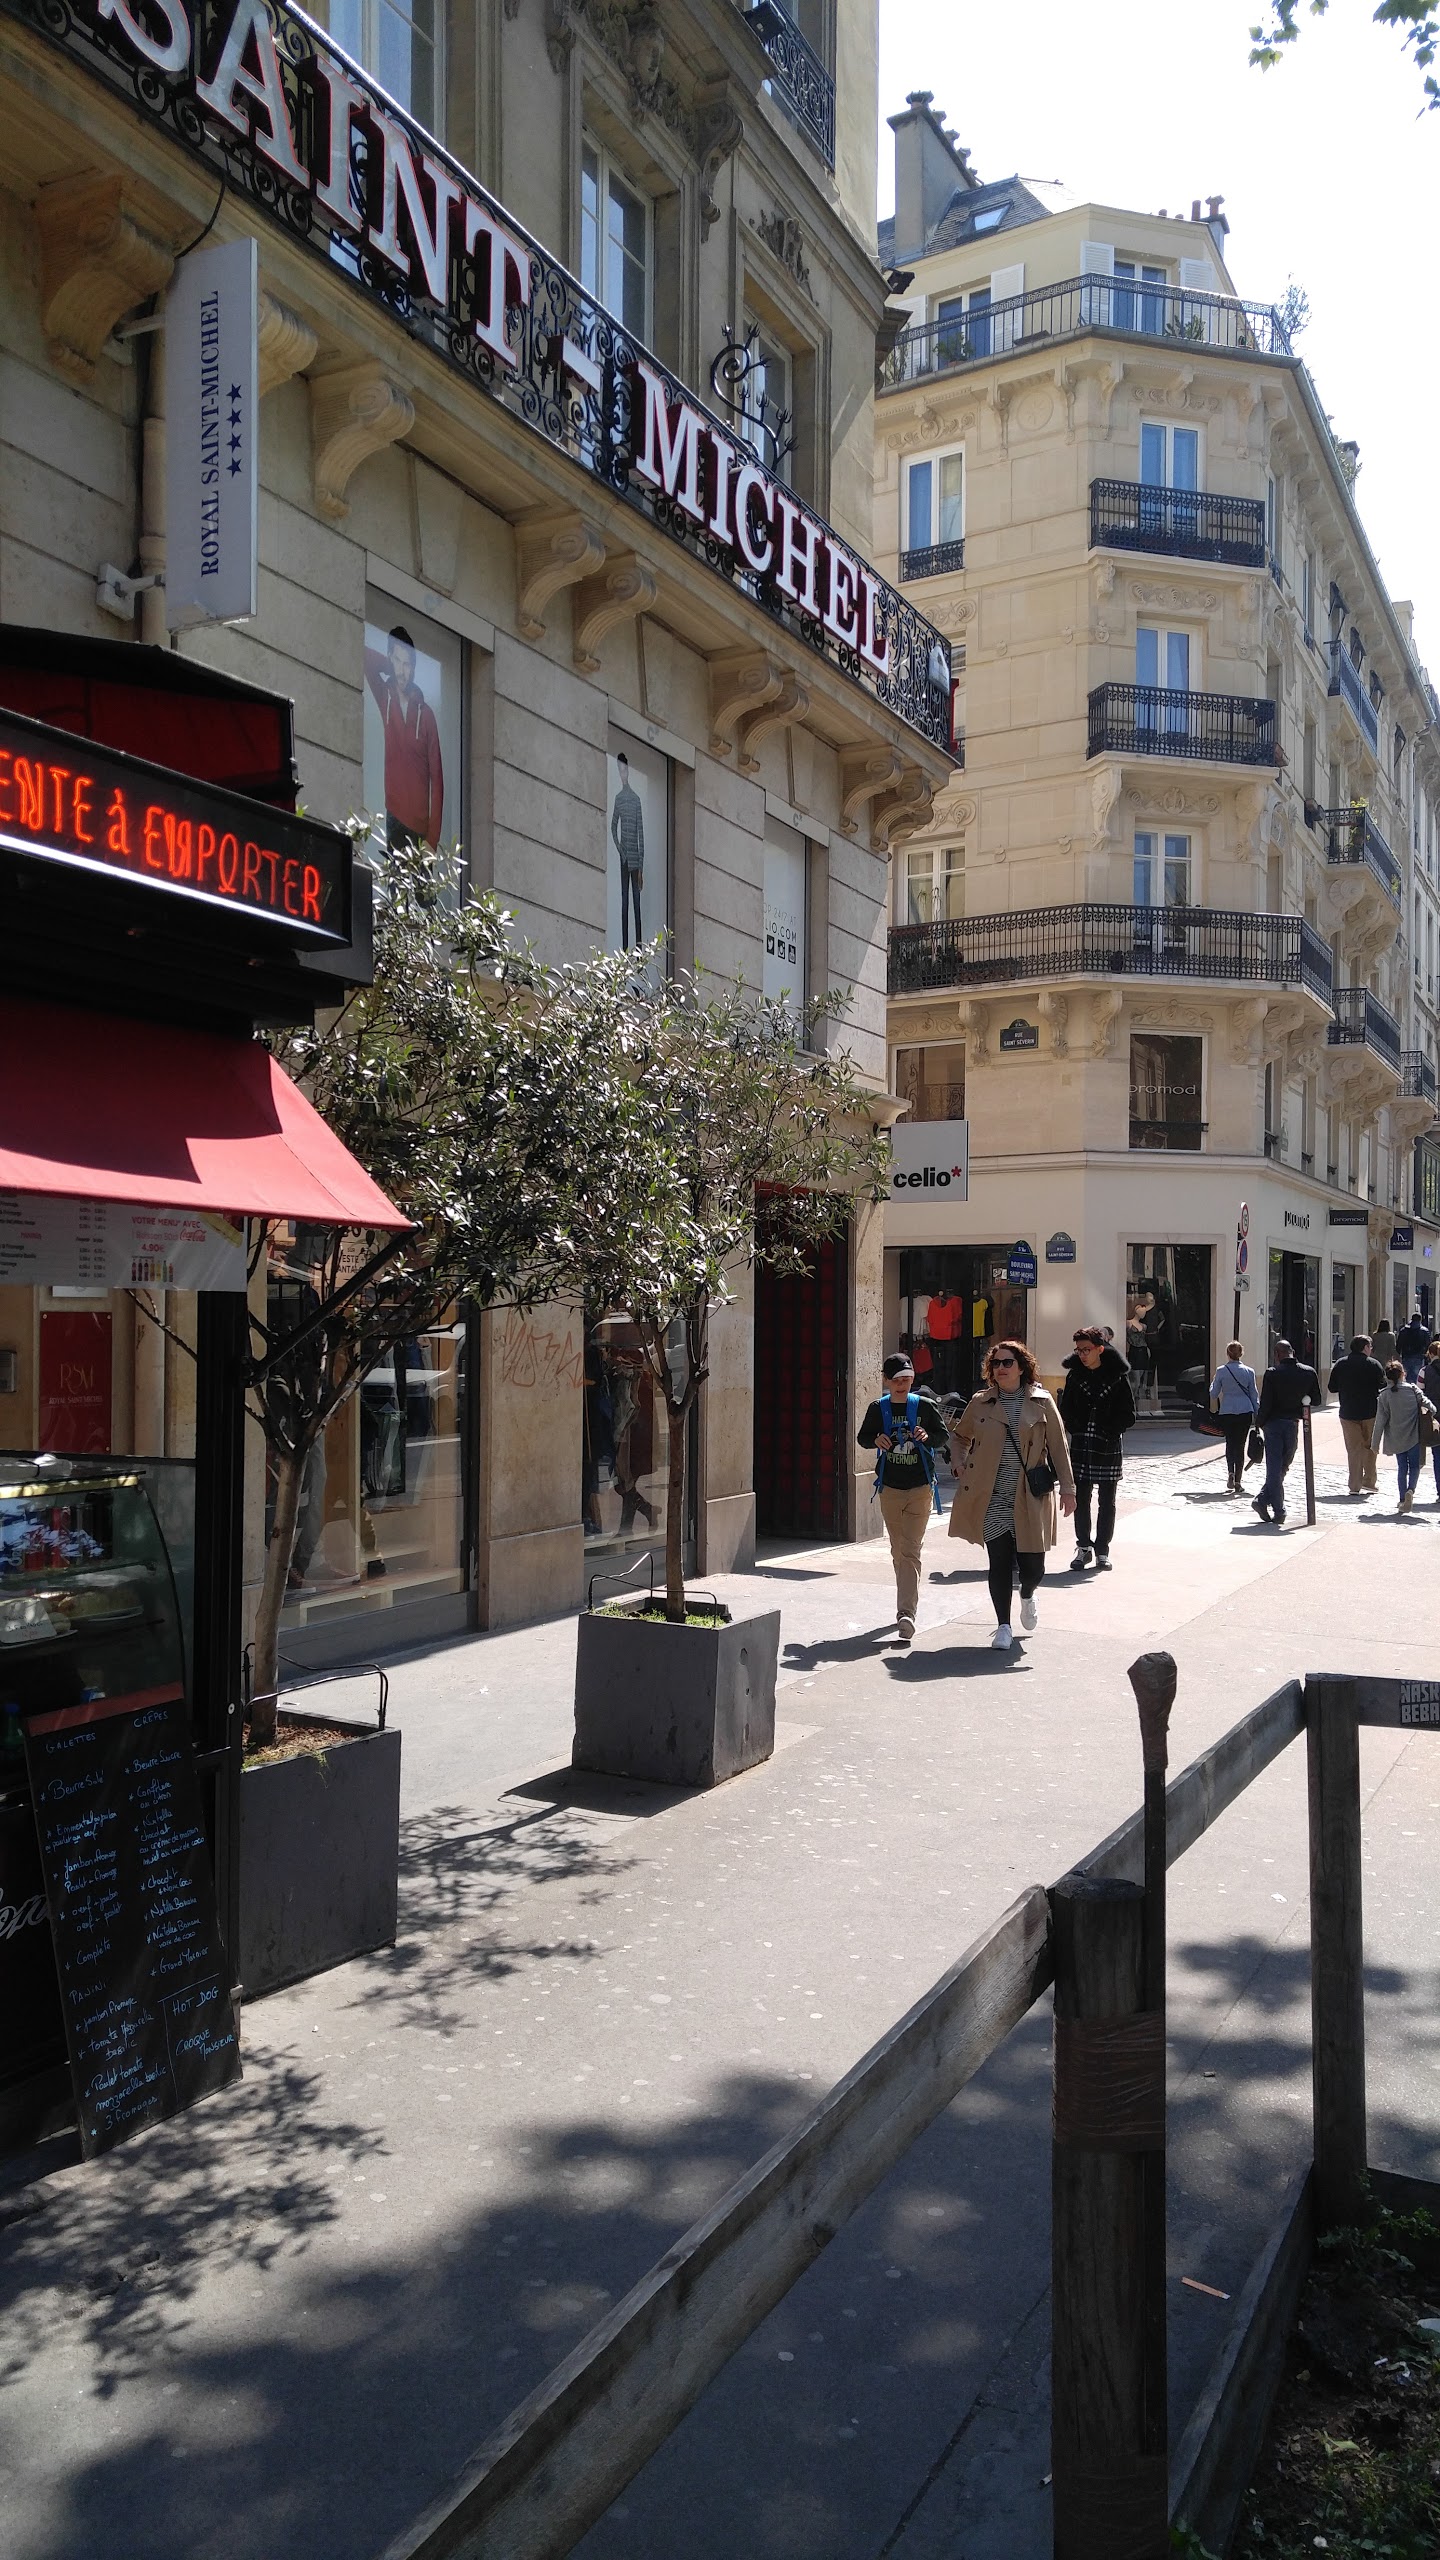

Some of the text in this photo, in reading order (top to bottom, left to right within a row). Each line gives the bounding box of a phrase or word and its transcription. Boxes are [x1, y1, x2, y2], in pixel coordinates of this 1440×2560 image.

[200, 289, 220, 578] ROYAL SAINT-MICHEL
[630, 361, 890, 677] MICHEL
[106, 787, 130, 855] à
[143, 805, 322, 923] EMPORTER
[764, 918, 797, 943] LIO.COM
[893, 1166, 951, 1188] celio
[131, 1216, 156, 1225] VOTRE
[183, 1220, 201, 1228] AVEC
[1009, 1270, 1035, 1280] SAINT-MICHEL
[1010, 1260, 1034, 1270] BOULEVARD
[133, 1711, 168, 1728] CRÊPES
[45, 1732, 97, 1753] GALETTES
[133, 1758, 159, 1773] Beurre
[48, 1779, 85, 1800] Beurre
[172, 1986, 219, 2017] HOT DOG
[175, 2029, 211, 2057] CROQUE
[105, 2115, 113, 2131] 3
